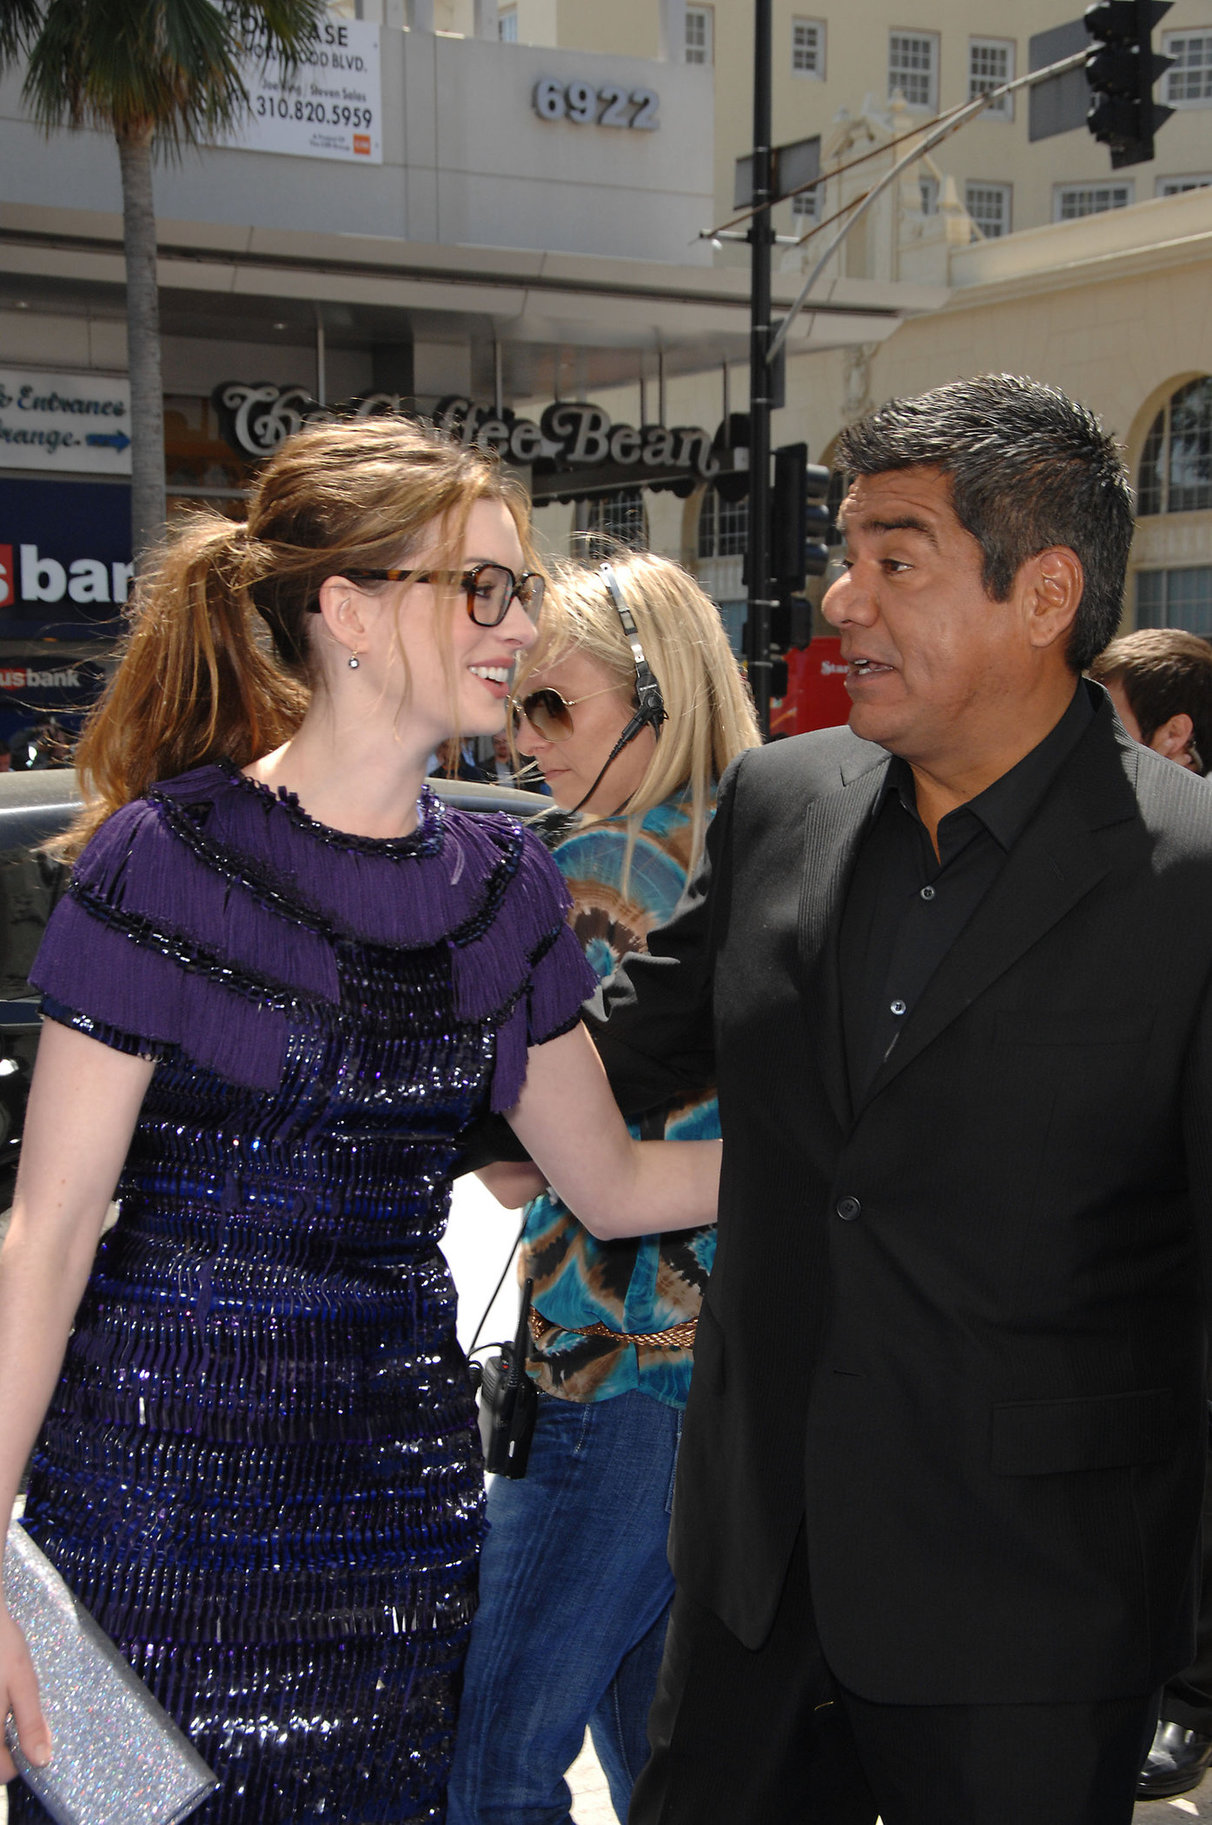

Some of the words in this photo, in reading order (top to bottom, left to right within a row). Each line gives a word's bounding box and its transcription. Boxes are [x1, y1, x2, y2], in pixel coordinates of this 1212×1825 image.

[332, 52, 368, 74] BLVD.
[257, 95, 372, 128] 310.820.5959
[533, 78, 660, 130] 6922
[17, 384, 126, 417] Entrance
[0, 418, 81, 454] range.
[551, 405, 720, 477] Bean
